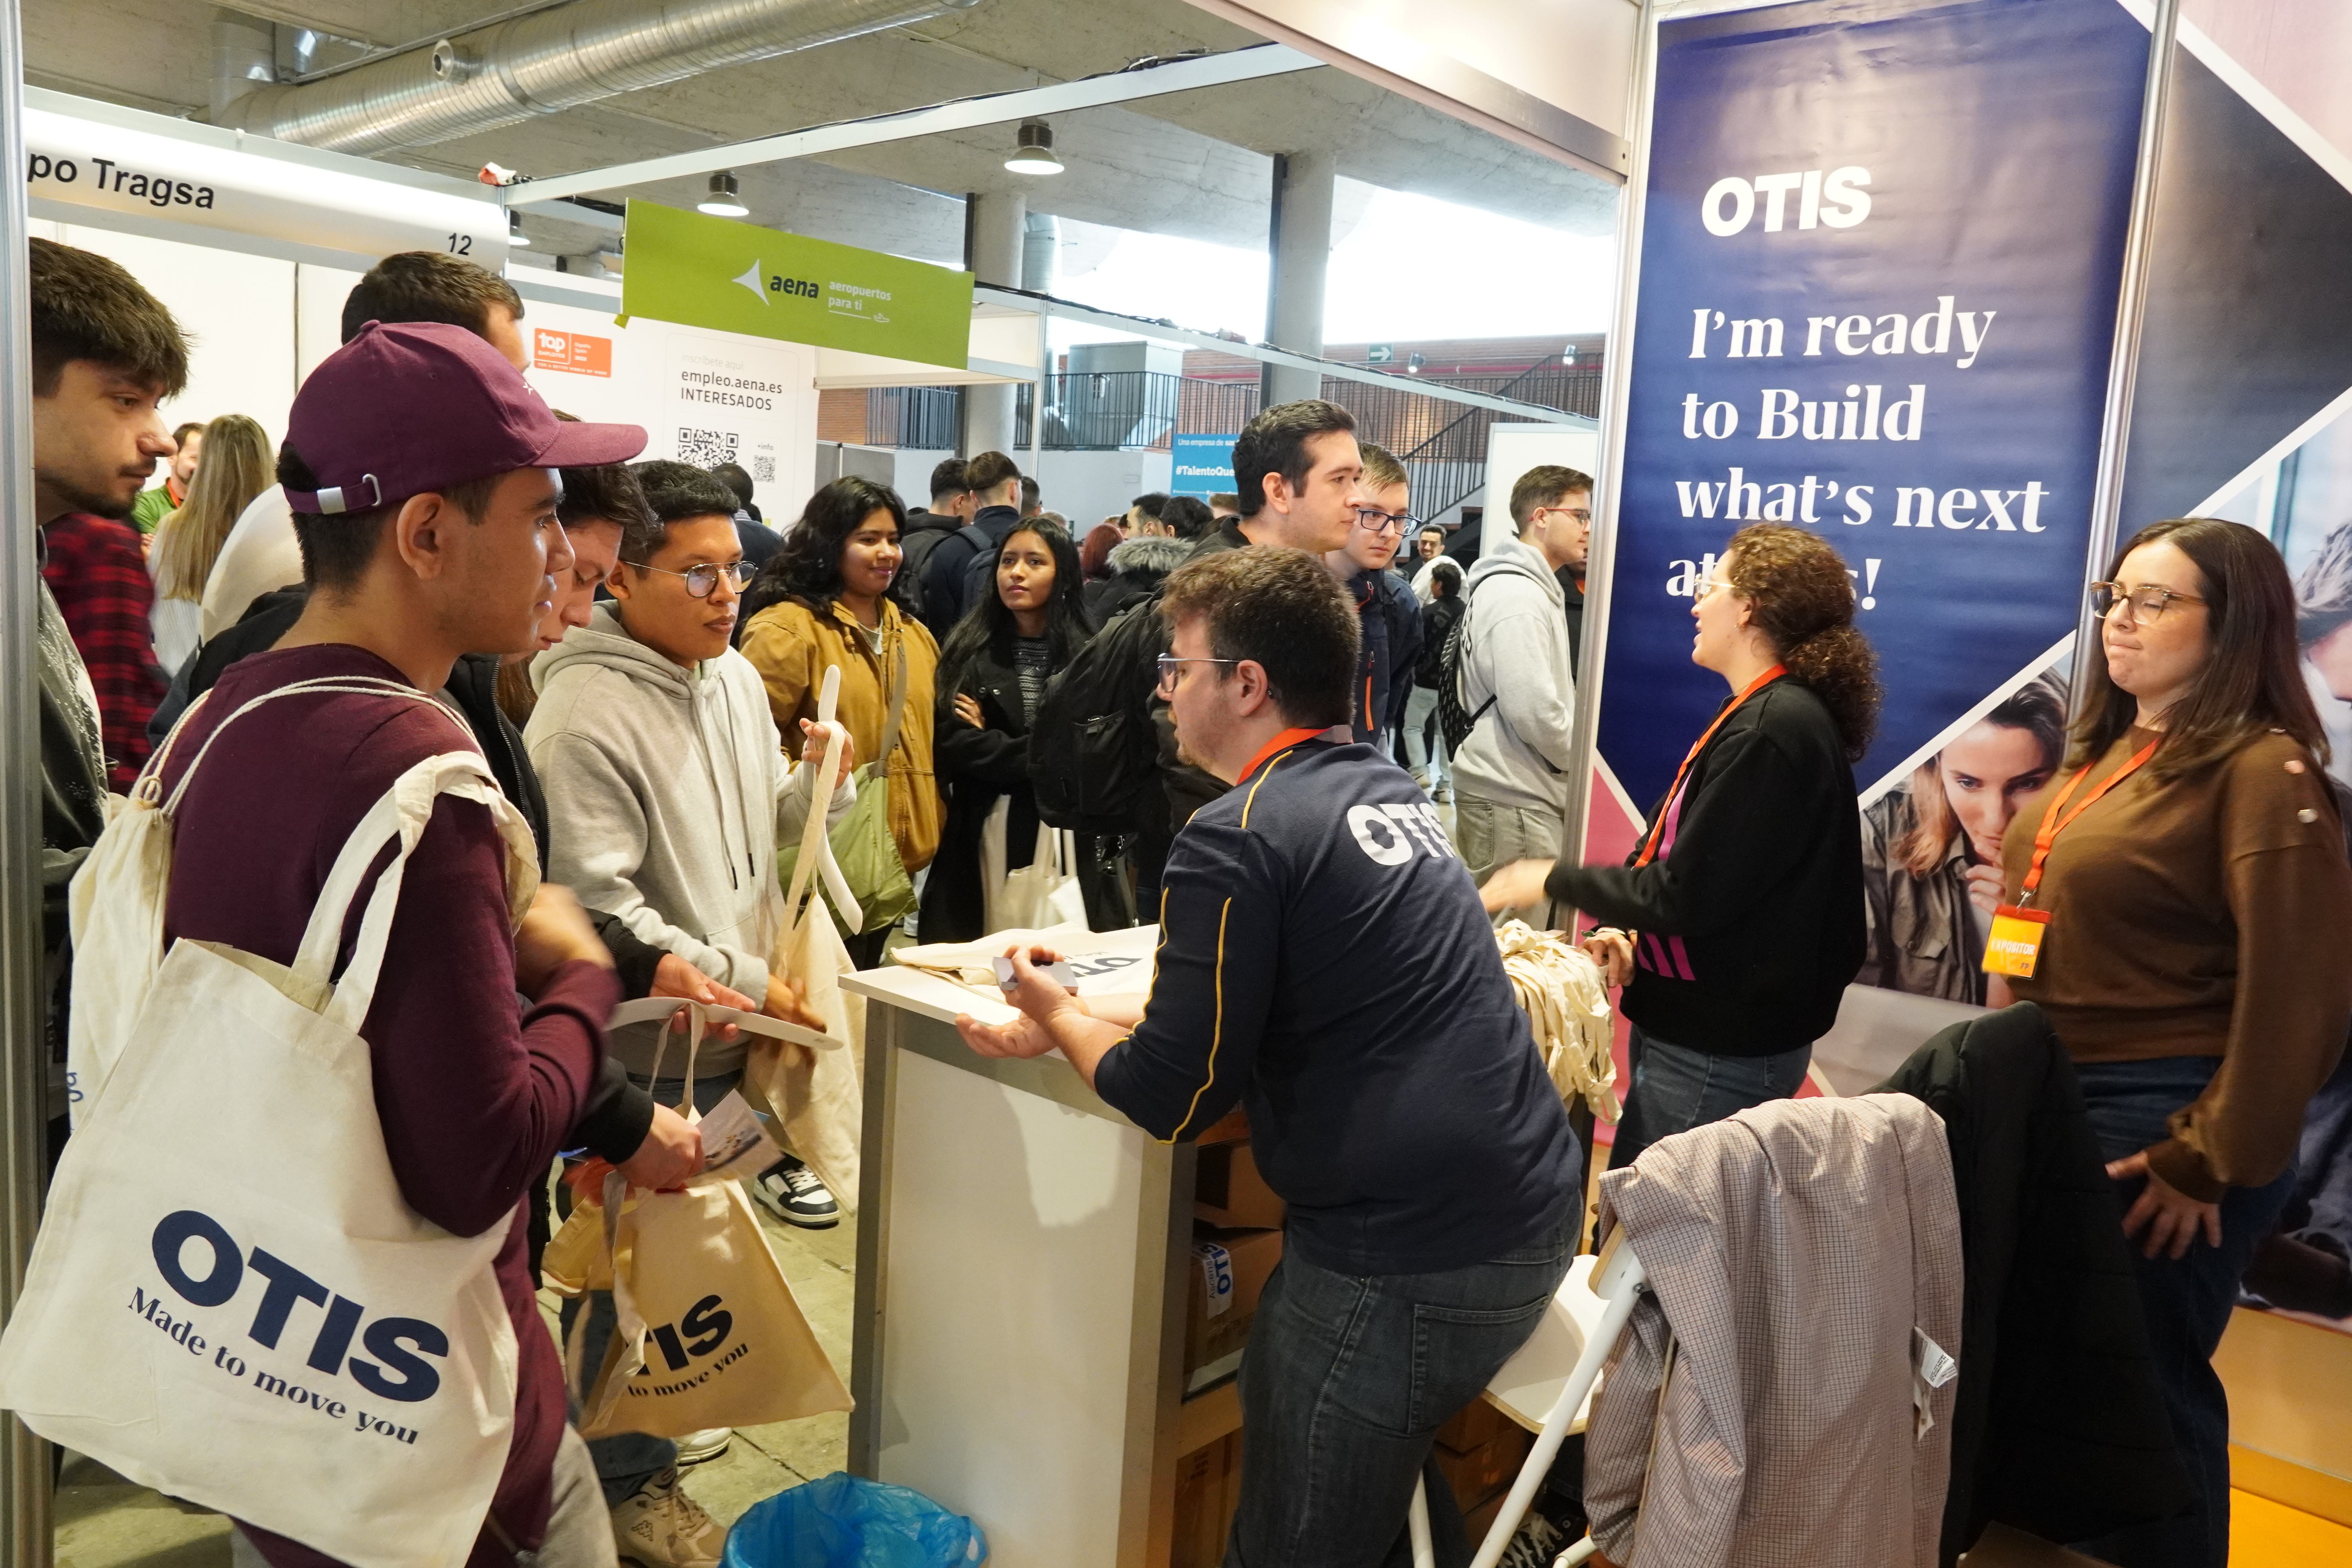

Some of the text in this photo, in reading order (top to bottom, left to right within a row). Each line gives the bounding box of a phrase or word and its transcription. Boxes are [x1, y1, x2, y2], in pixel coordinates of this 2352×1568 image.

[92, 158, 214, 209] Tragsa
[1701, 166, 1872, 236] OTIS
[448, 233, 472, 255] 12
[770, 275, 819, 298] aena
[829, 281, 891, 301] aeropuertos
[828, 296, 862, 310] para ti
[538, 332, 566, 352] top
[1688, 296, 1997, 368] I'm ready
[538, 350, 565, 358] EMPLOYER
[682, 371, 782, 394] empleo.aena.es
[681, 387, 771, 410] INTERESADOS
[1682, 384, 1926, 441] to Build
[1176, 466, 1234, 476] #TalentoQue
[1675, 467, 2049, 532] what's next
[1991, 938, 2036, 956] EXPOSITOR
[152, 1210, 448, 1402] OTIS
[128, 1286, 418, 1445] Made to move you
[653, 1371, 709, 1396] move
[713, 1343, 748, 1375] you
